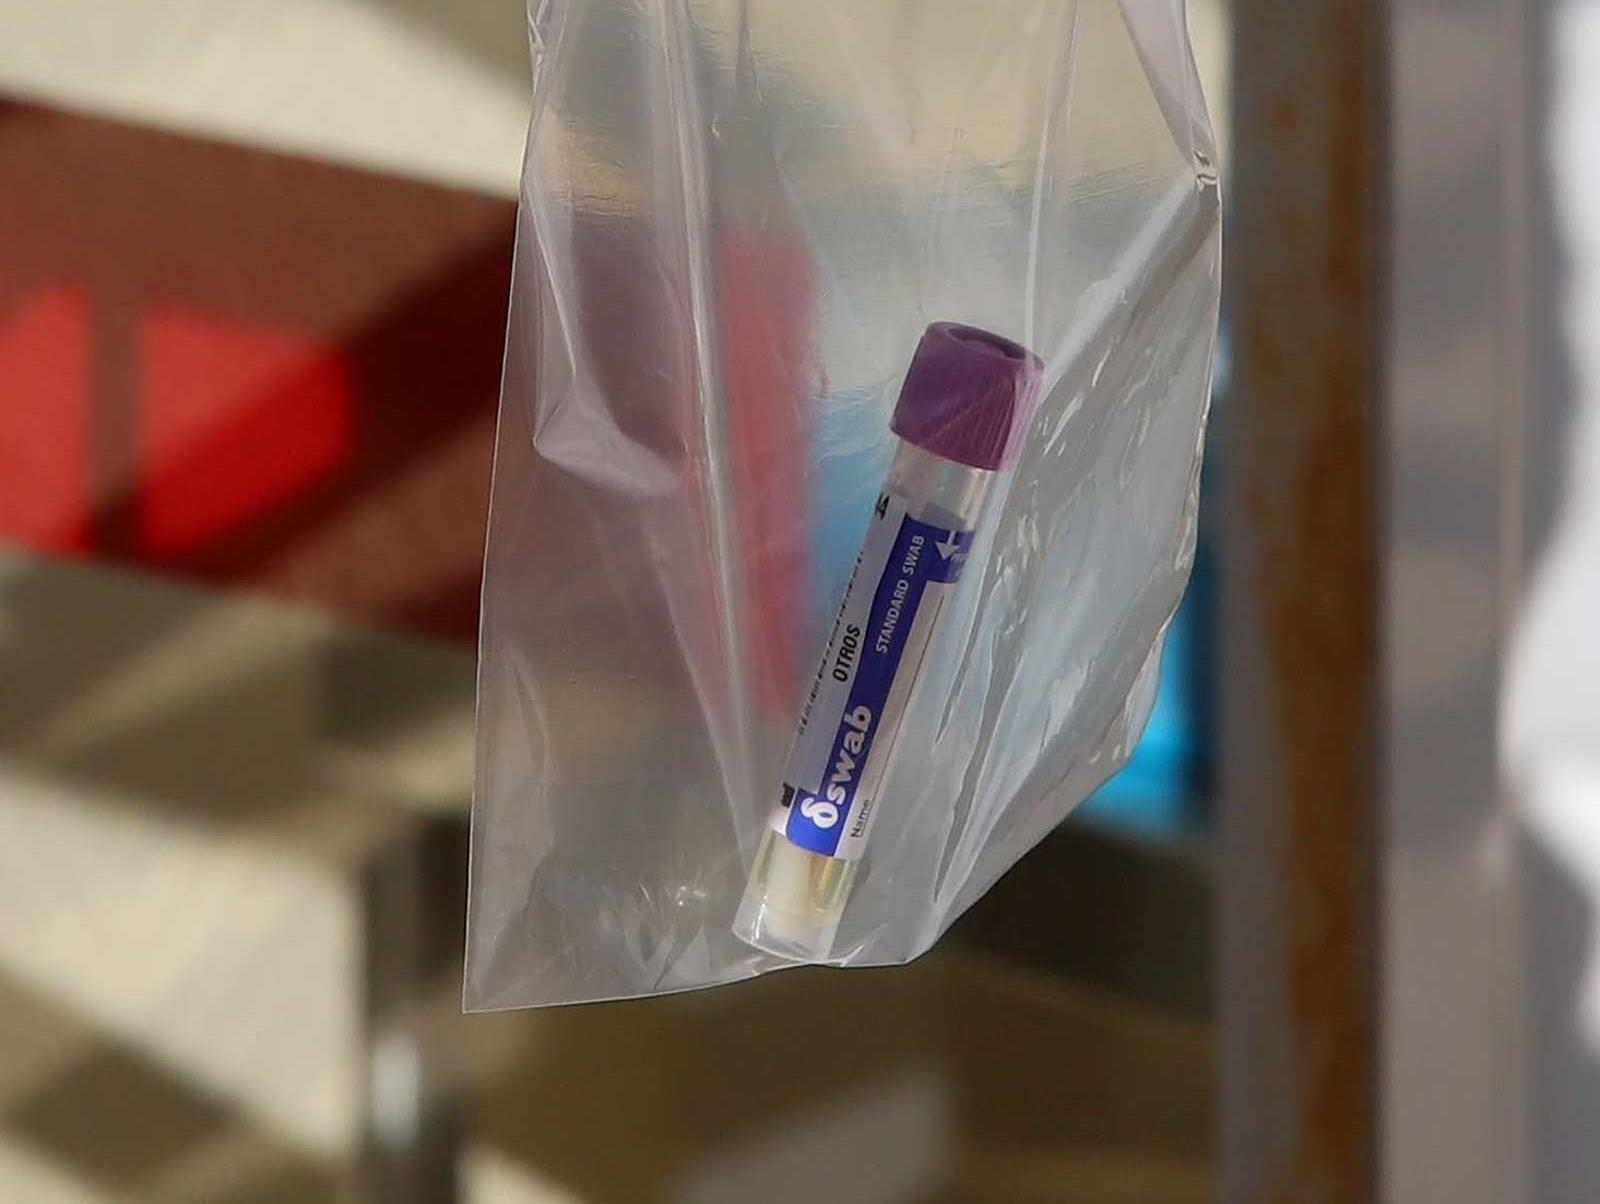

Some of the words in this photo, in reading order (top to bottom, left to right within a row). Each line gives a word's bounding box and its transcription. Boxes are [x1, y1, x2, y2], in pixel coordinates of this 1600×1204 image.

[876, 579, 909, 654] STANDARD
[903, 535, 925, 575] SWAB
[833, 624, 860, 682] OTROS
[851, 799, 869, 837] Name
